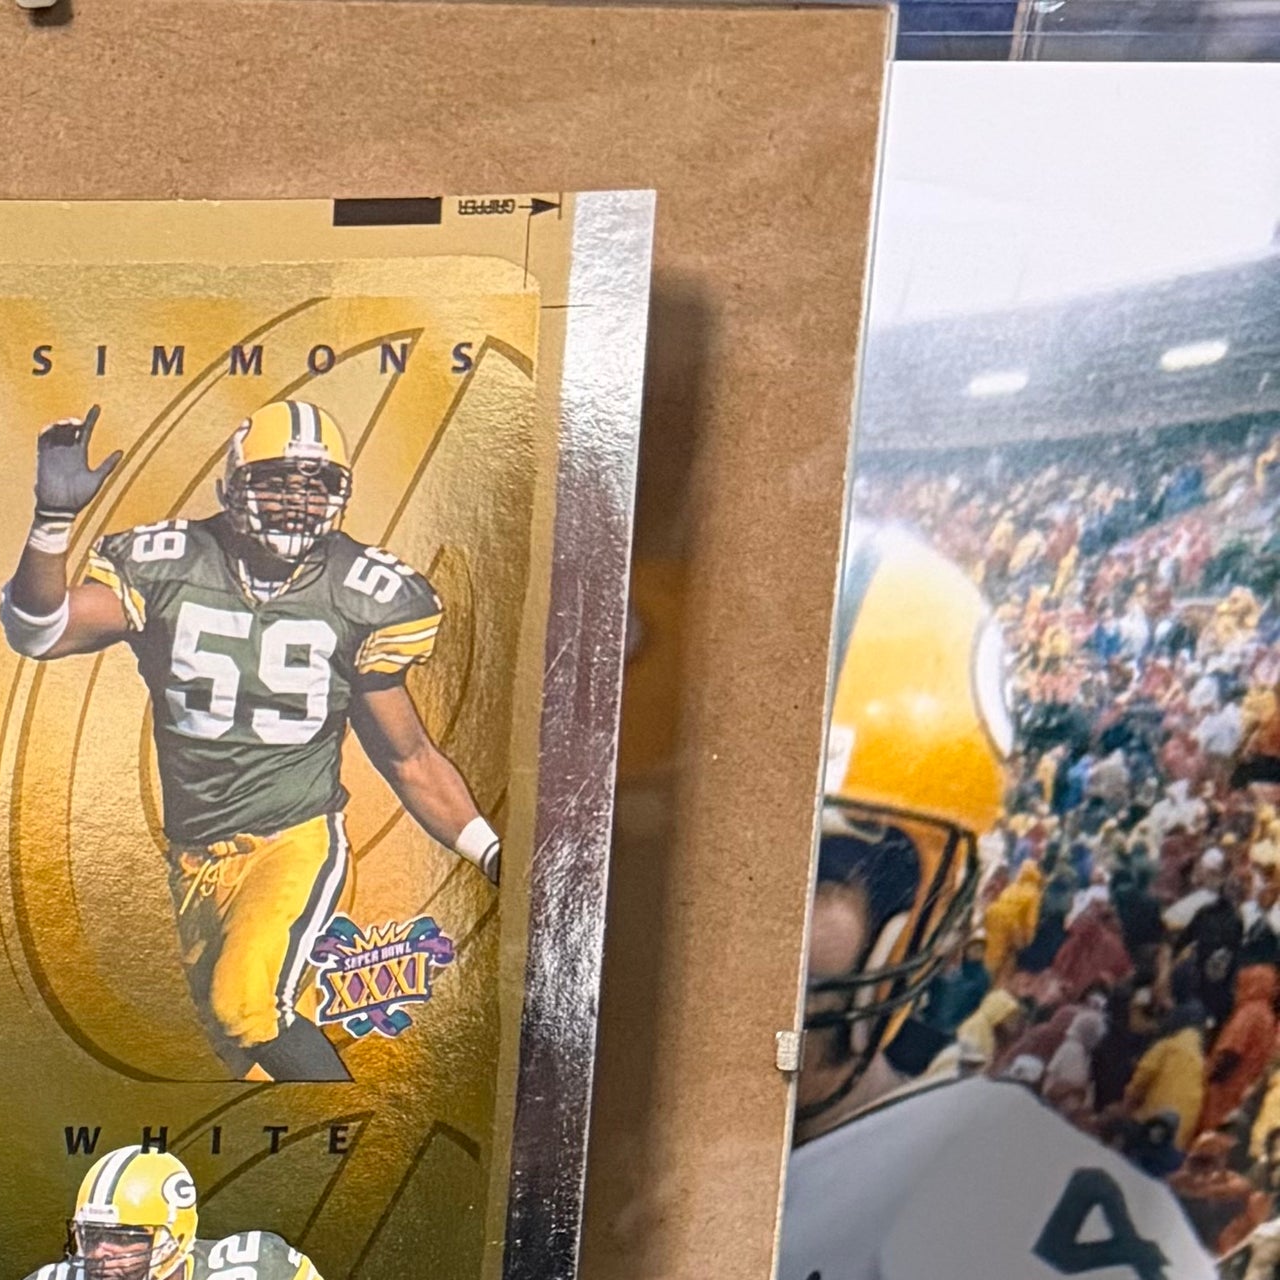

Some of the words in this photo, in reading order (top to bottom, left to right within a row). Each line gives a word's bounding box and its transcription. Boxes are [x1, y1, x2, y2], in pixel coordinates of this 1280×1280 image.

[32, 341, 473, 376] SIMMONS
[166, 602, 337, 744] 59
[345, 952, 378, 970] SUPER
[382, 941, 412, 959] BOWL
[326, 952, 428, 1015] XXXI
[63, 1125, 350, 1156] WHITE
